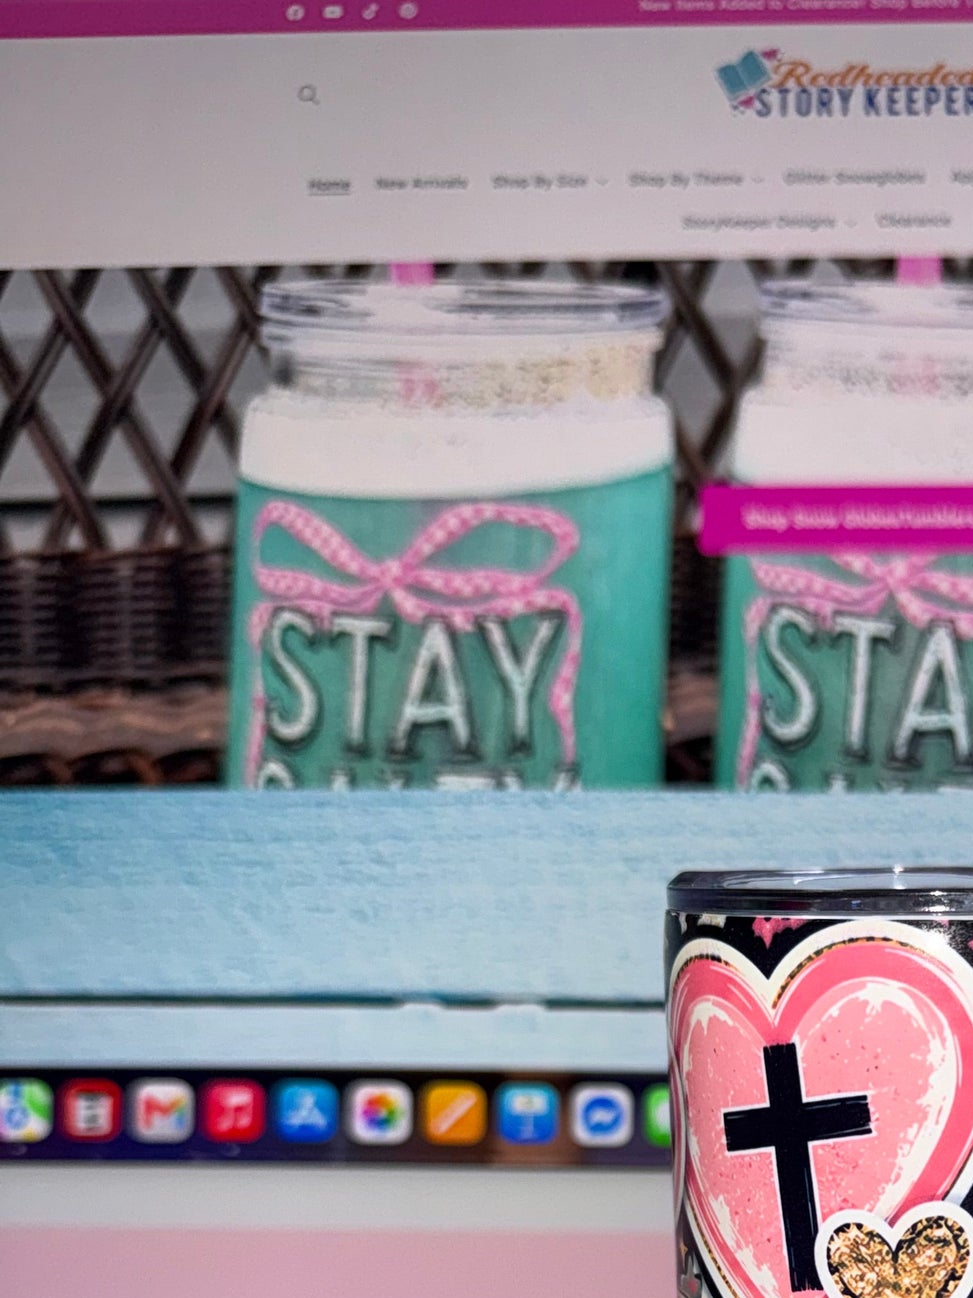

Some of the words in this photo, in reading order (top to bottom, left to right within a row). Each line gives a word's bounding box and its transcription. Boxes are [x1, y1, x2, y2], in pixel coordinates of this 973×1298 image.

[755, 86, 854, 118] STORY
[308, 177, 351, 192] Home
[376, 176, 408, 191] New
[492, 174, 530, 190] Shop
[533, 174, 553, 191] By
[628, 172, 665, 189] Shop
[669, 172, 690, 190] By
[875, 212, 952, 229] Clearance
[267, 606, 566, 758] STAY
